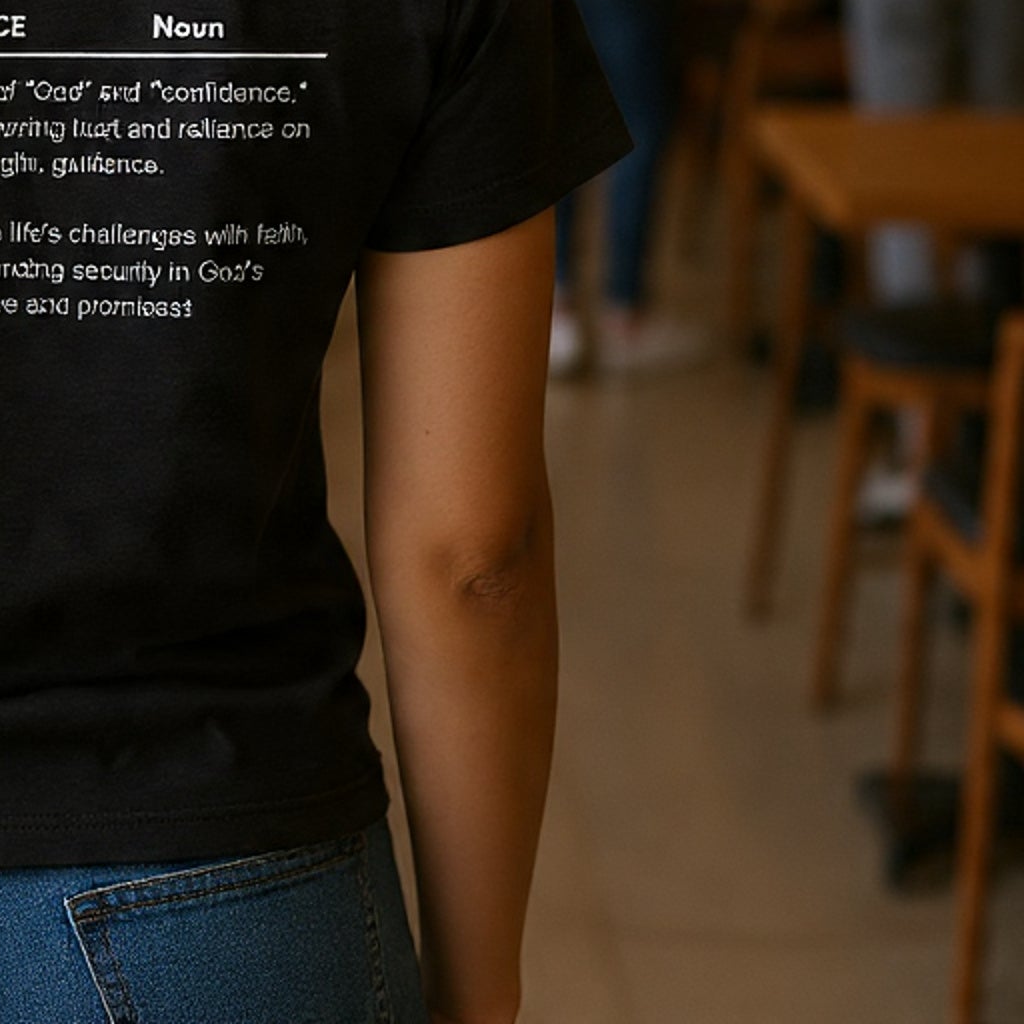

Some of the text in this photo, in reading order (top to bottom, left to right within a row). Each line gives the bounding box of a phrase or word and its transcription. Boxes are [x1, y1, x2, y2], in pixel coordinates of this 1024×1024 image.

[152, 13, 225, 39] Noun
[127, 117, 171, 140] and
[281, 122, 310, 139] on
[168, 261, 190, 282] in
